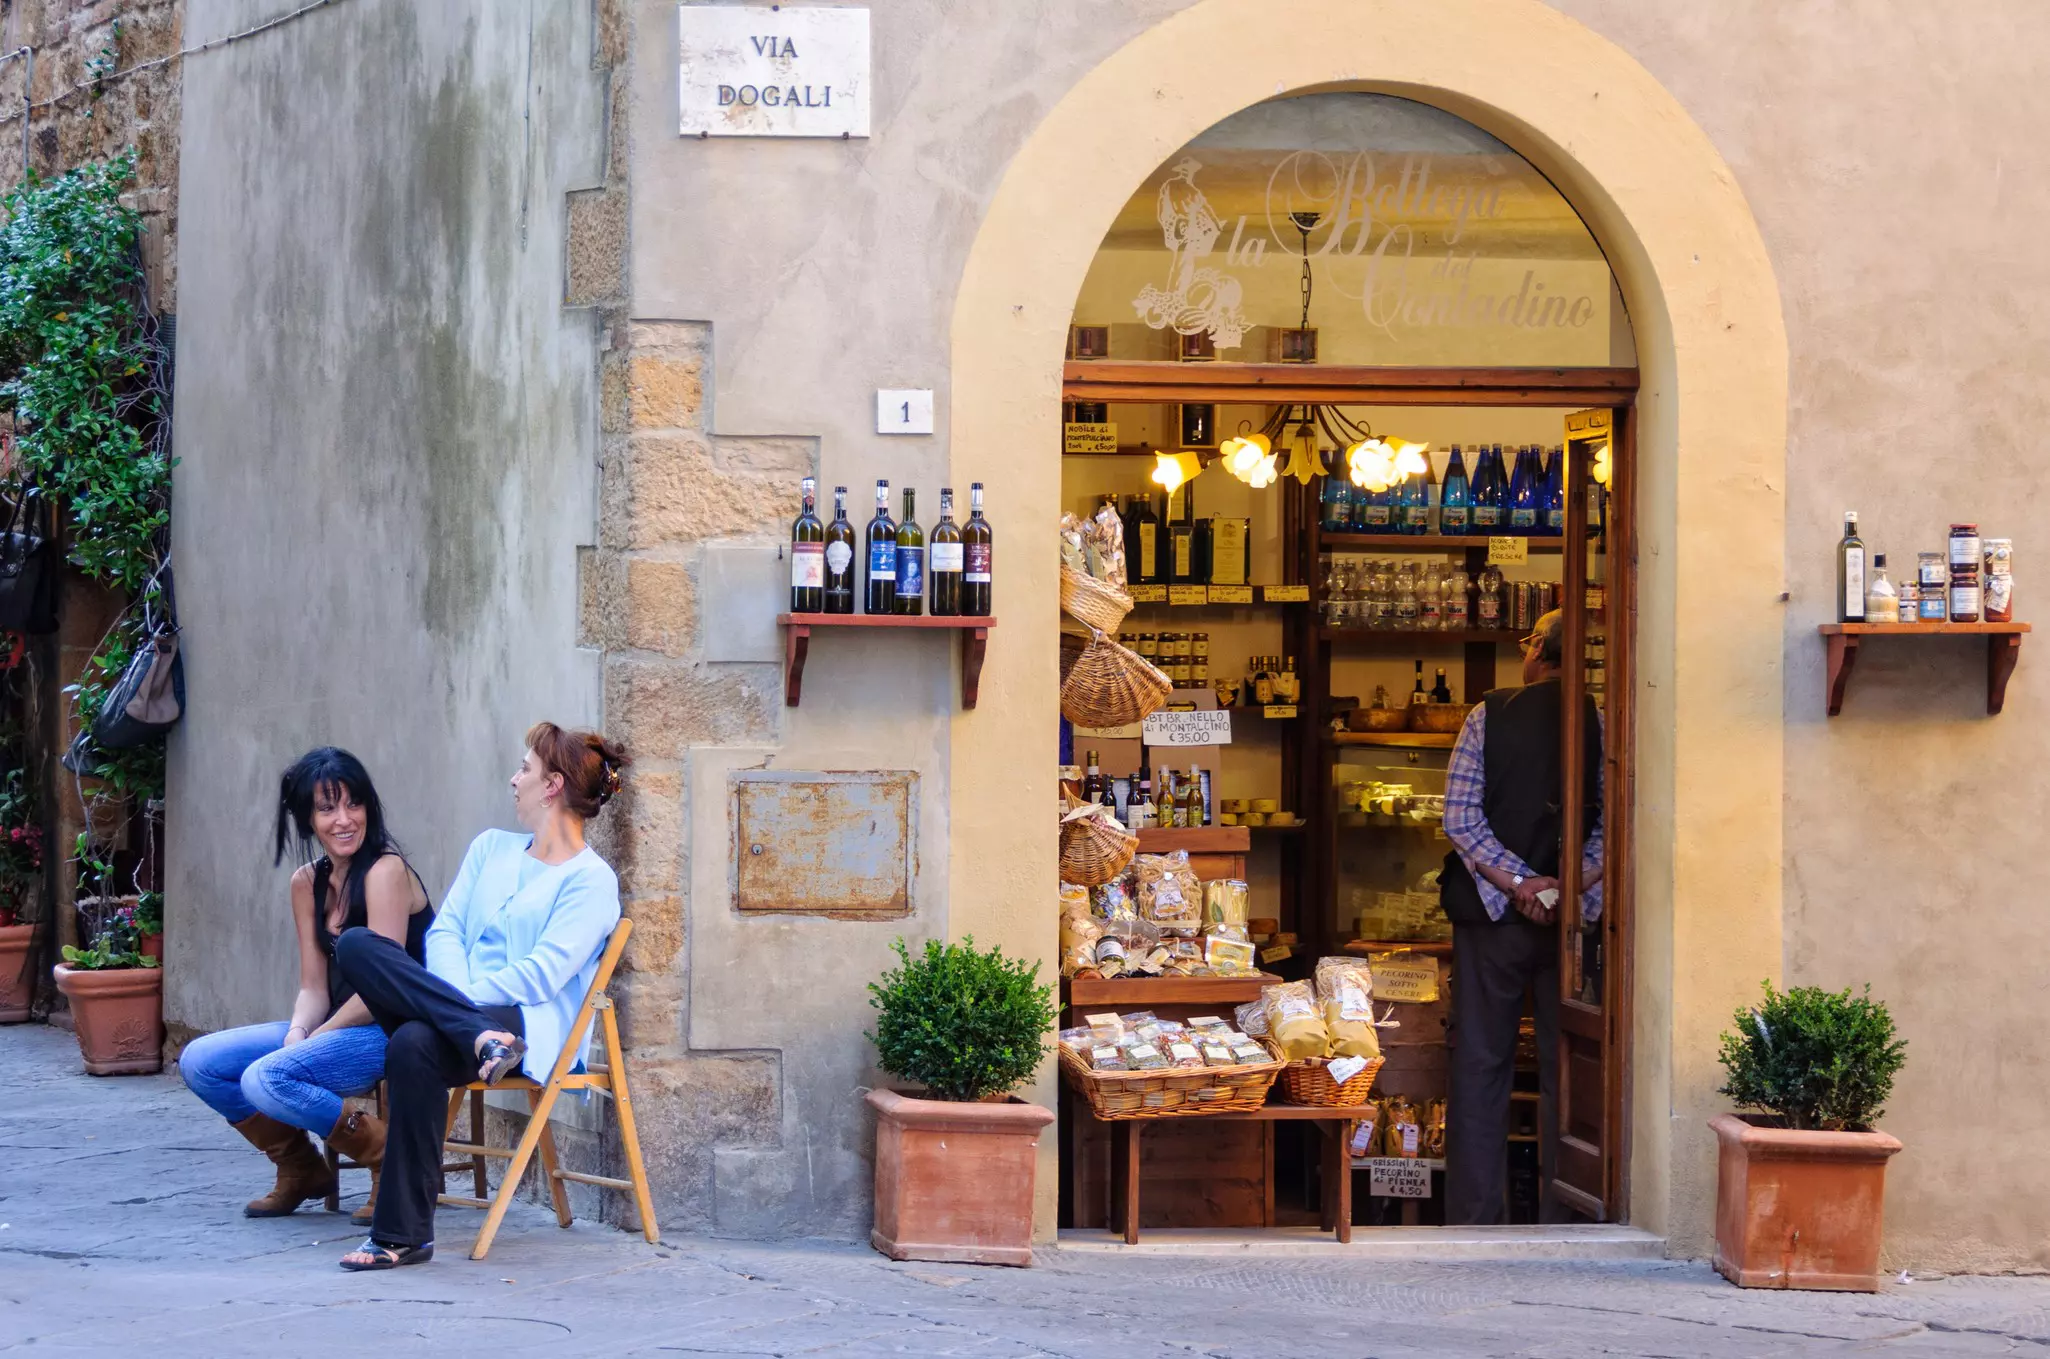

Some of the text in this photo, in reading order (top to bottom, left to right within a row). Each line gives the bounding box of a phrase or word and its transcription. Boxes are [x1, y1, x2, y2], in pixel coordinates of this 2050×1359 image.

[751, 36, 798, 58] VIA
[718, 85, 832, 107] DOGALI
[1226, 150, 1506, 267] la Bottega
[1431, 249, 1477, 279] del
[1342, 222, 1596, 342] Contadino
[900, 401, 910, 423] 1
[1159, 722, 1230, 733] MONTALCINO
[1380, 970, 1428, 980] PECORINO
[1388, 980, 1419, 988] SOTTO
[1372, 1158, 1409, 1167] GRISSINI
[1374, 1167, 1421, 1178] PECORINO
[1388, 1177, 1427, 1186] PIENZA
